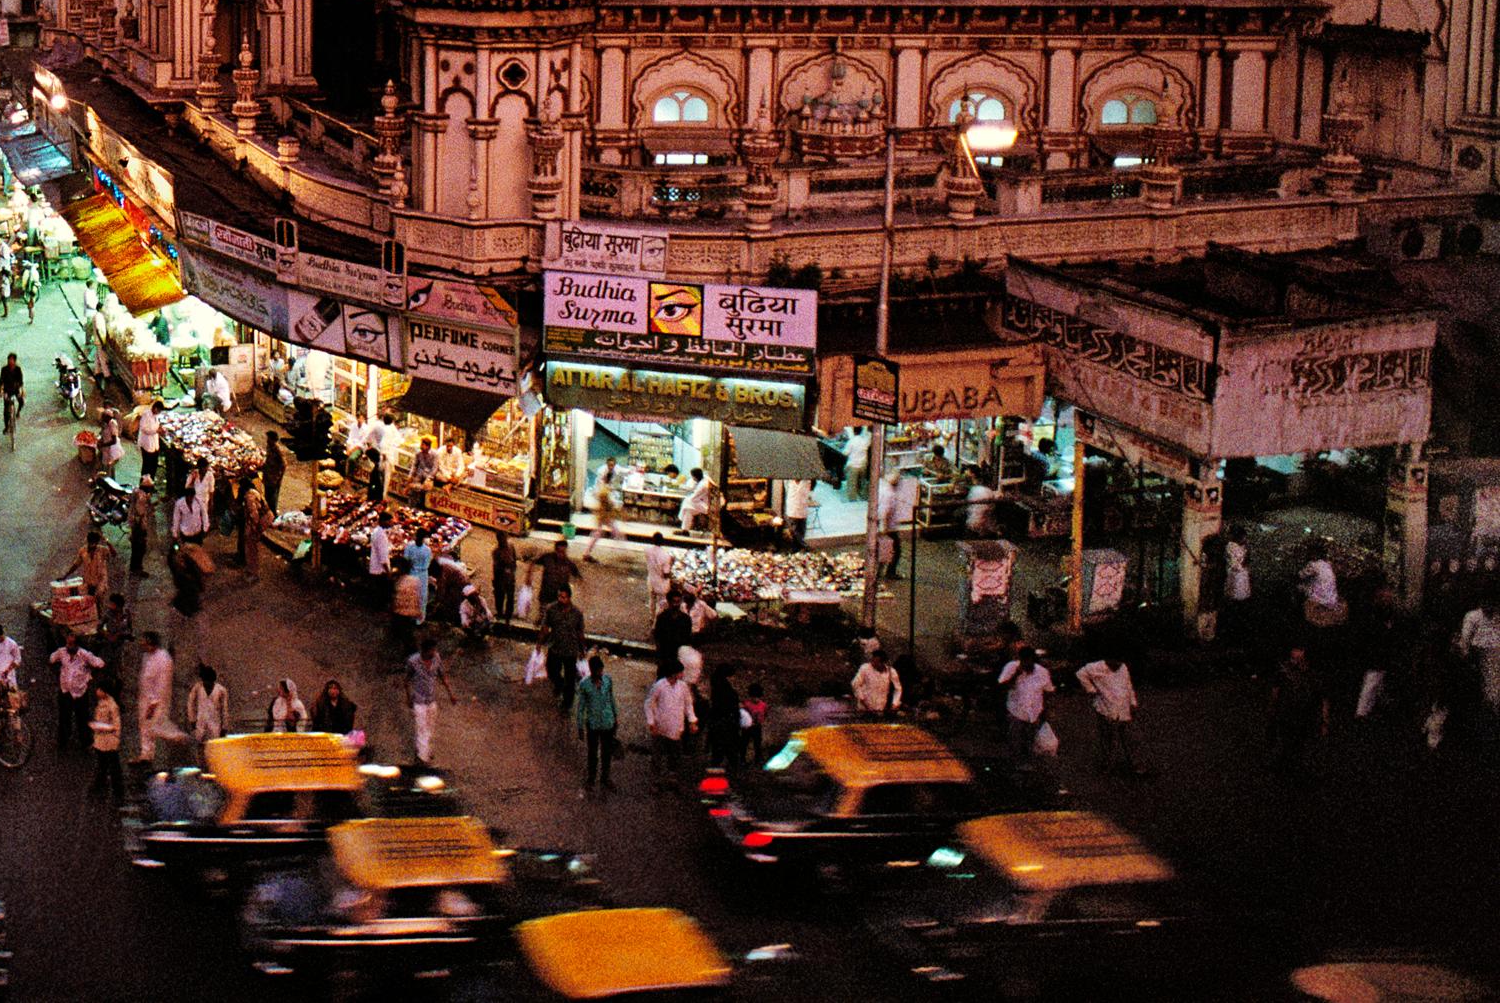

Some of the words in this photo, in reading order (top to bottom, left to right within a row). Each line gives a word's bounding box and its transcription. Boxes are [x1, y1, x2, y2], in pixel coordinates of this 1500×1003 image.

[554, 276, 637, 302] Budhia
[718, 288, 799, 316] बुढिया
[558, 300, 638, 329] Surma
[723, 316, 785, 341] सुरमा
[410, 323, 479, 349] PERFUME
[482, 340, 515, 356] CORNER
[553, 366, 613, 390] ATTAR
[618, 372, 644, 393] AL
[646, 377, 711, 400] HAFIZ
[715, 382, 729, 402] &
[735, 384, 799, 408] BROS.
[902, 386, 1003, 413] UBABA
